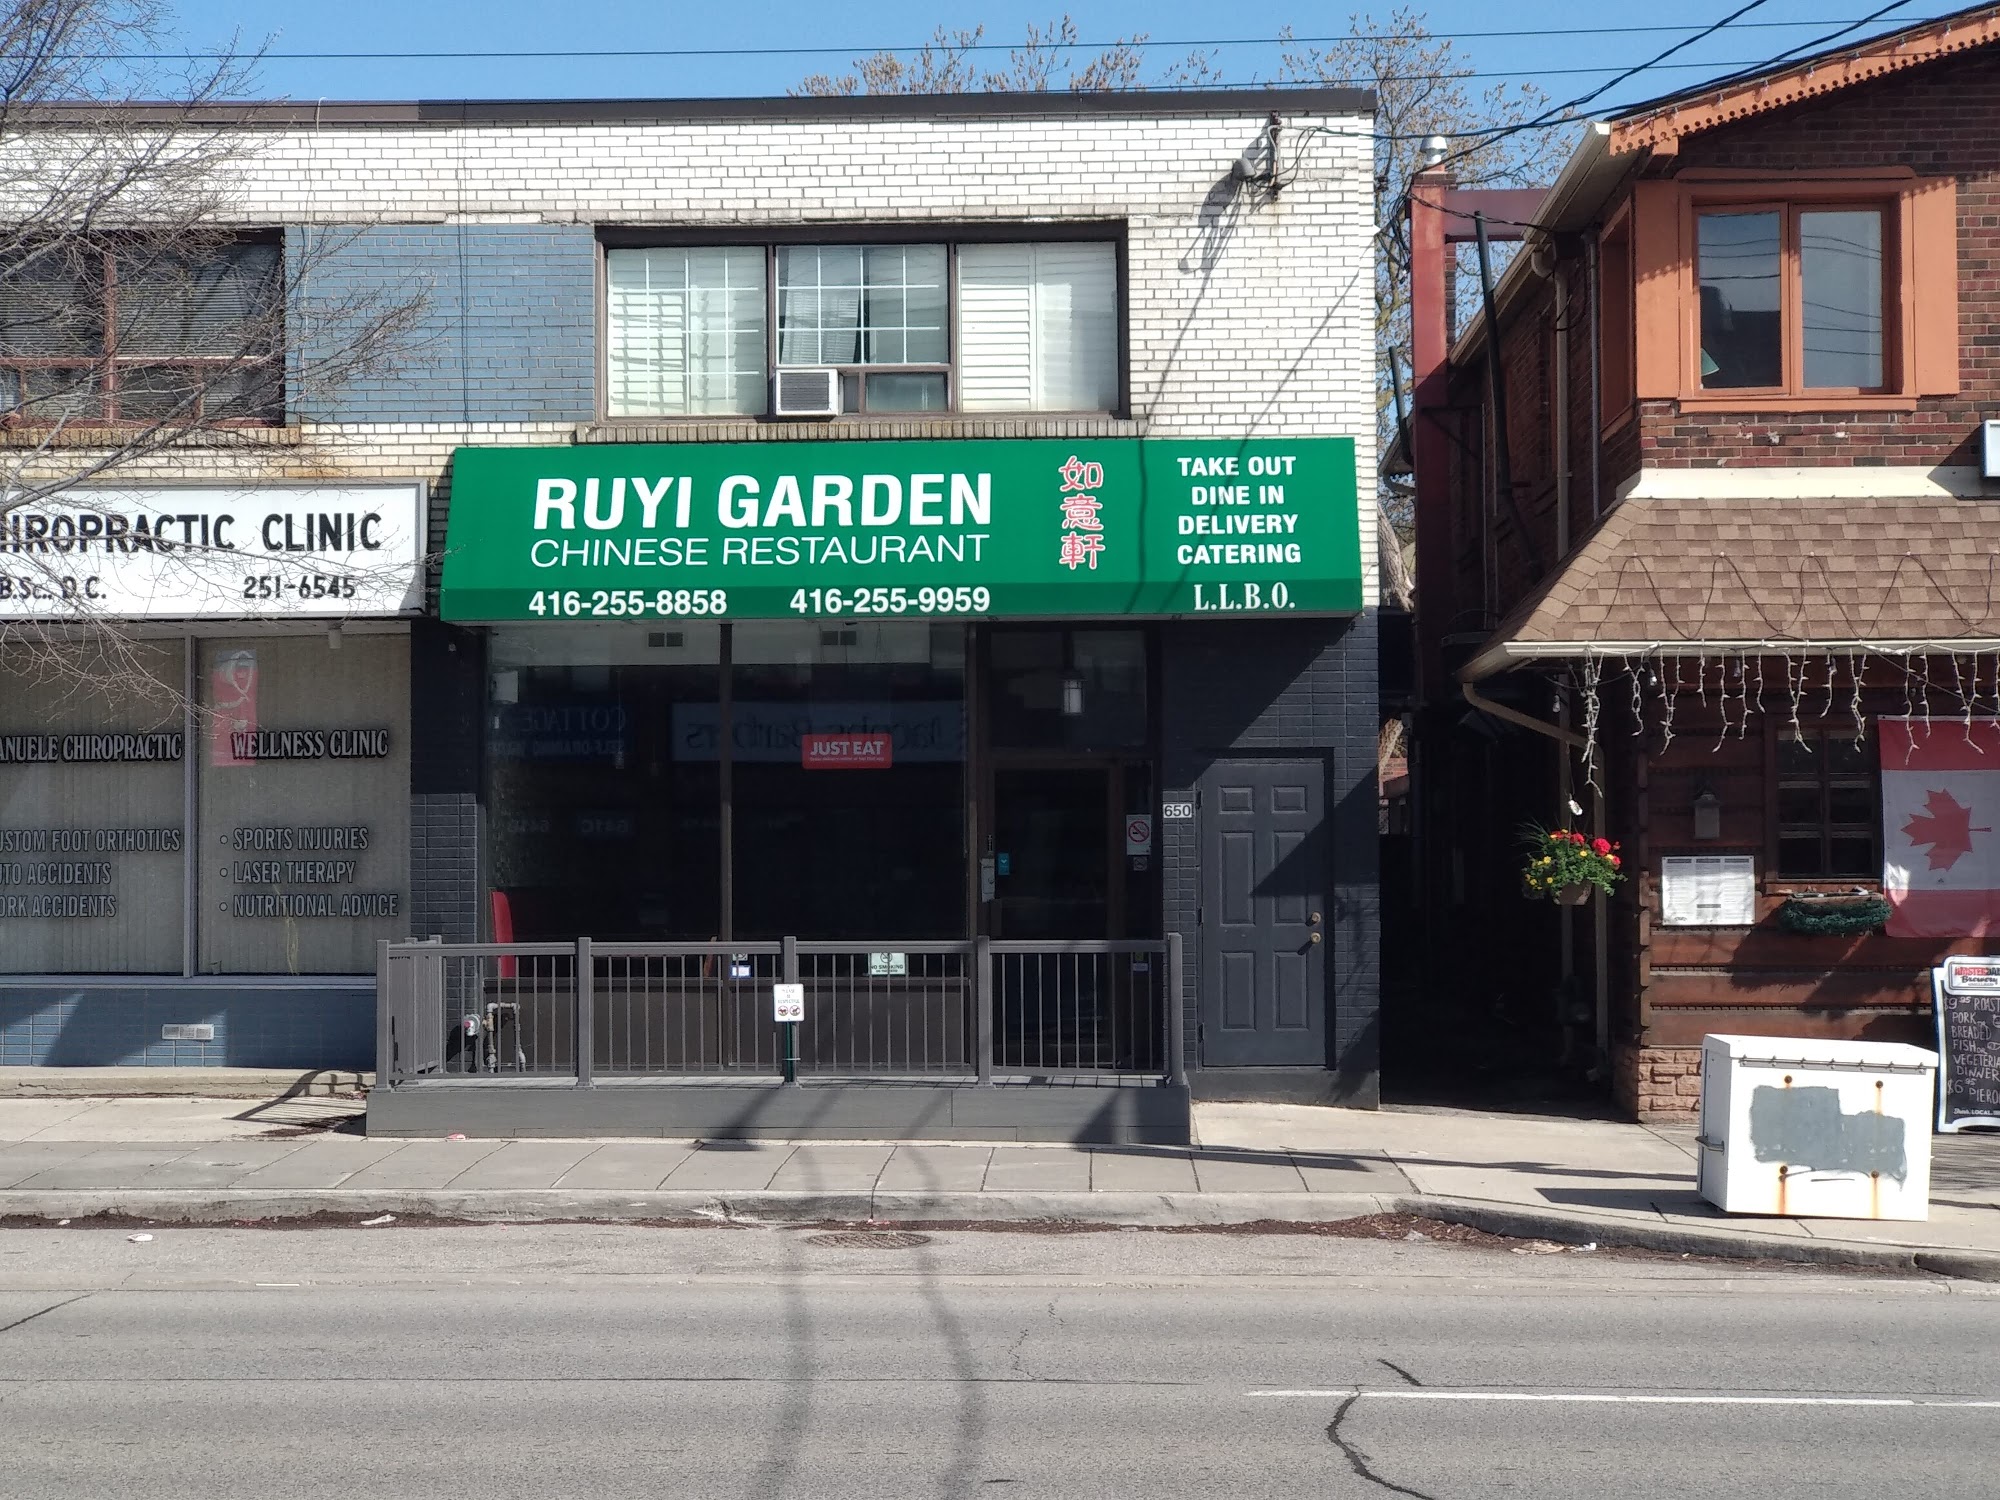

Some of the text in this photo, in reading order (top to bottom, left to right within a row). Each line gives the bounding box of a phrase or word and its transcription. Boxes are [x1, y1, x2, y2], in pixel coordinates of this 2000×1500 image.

[1177, 455, 1297, 477] TAKE OUT
[533, 473, 993, 530] RUYI GARDEN
[1191, 485, 1285, 505] DINE IN
[1058, 455, 1106, 570] 如意軒
[1178, 513, 1298, 535] DELIVERY
[262, 512, 382, 552] CLINIC
[530, 534, 991, 568] CHINESE RESTAURANT
[1177, 543, 1301, 565] CATERING
[243, 575, 356, 599] 251-6545
[1194, 581, 1296, 610] L.L.B.O.
[529, 586, 991, 616] 416-255-8858 416-255-9959
[62, 733, 183, 761] CHIROPRACTIC
[231, 729, 389, 759] WELLNESS CLINIC
[810, 740, 885, 755] JUST EAT
[1164, 804, 1192, 817] 650
[51, 829, 91, 852] FOOT
[95, 829, 181, 852] ORTHOTICS
[233, 827, 369, 850] SPORTS INJURIES
[27, 862, 111, 885] ACCIDENTS
[234, 860, 356, 884] LASER THERAPY
[32, 895, 116, 918] ACCIDENTS
[233, 894, 399, 917] NUTRITIONAL ADVICE
[1960, 975, 1998, 985] Brewery
[1974, 997, 2000, 1013] ROAST
[1952, 1011, 1977, 1025] PORK
[1950, 1022, 1992, 1041] BREADED
[1952, 1039, 1977, 1053] FISH
